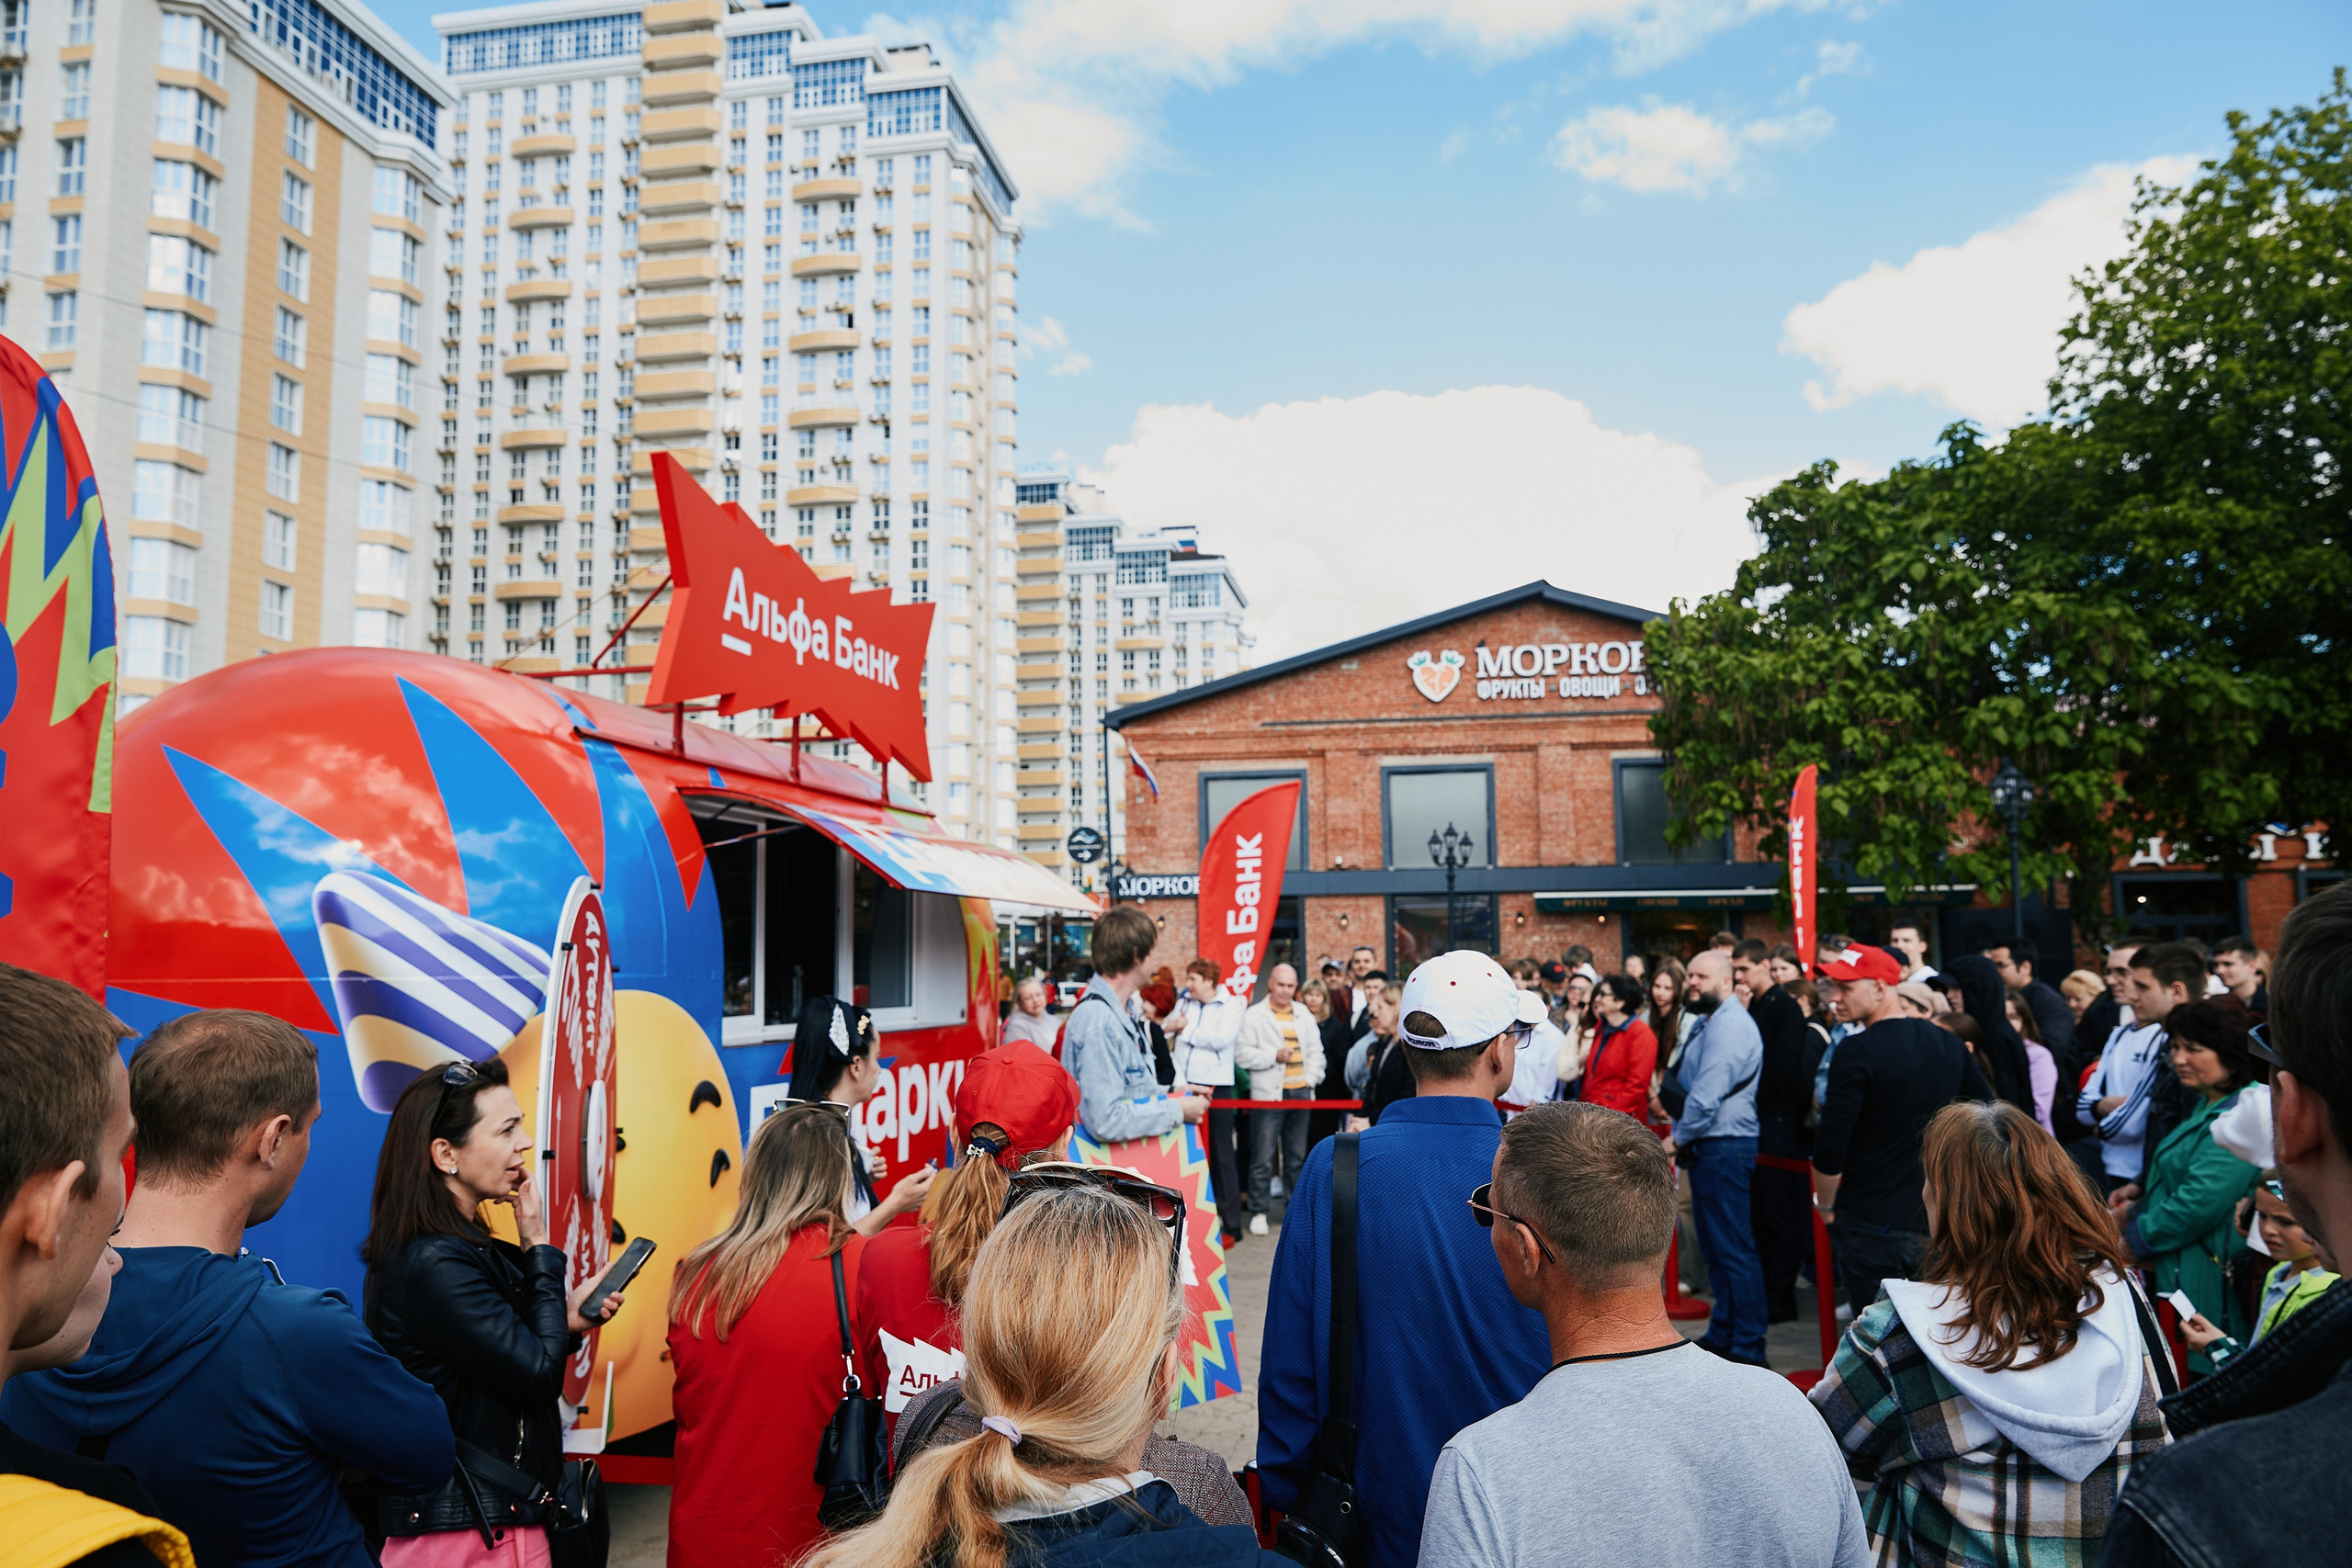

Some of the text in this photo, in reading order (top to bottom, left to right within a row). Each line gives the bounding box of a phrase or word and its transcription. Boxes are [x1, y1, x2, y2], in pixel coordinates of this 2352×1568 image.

[721, 566, 900, 691] Альфа Банк
[1476, 678, 1545, 700] ФРУКТЫ
[1559, 675, 1621, 699] ОВОЩИ
[1227, 832, 1263, 935] Банк
[585, 910, 601, 1057] АУТФИТ
[899, 1364, 960, 1390] Аль
